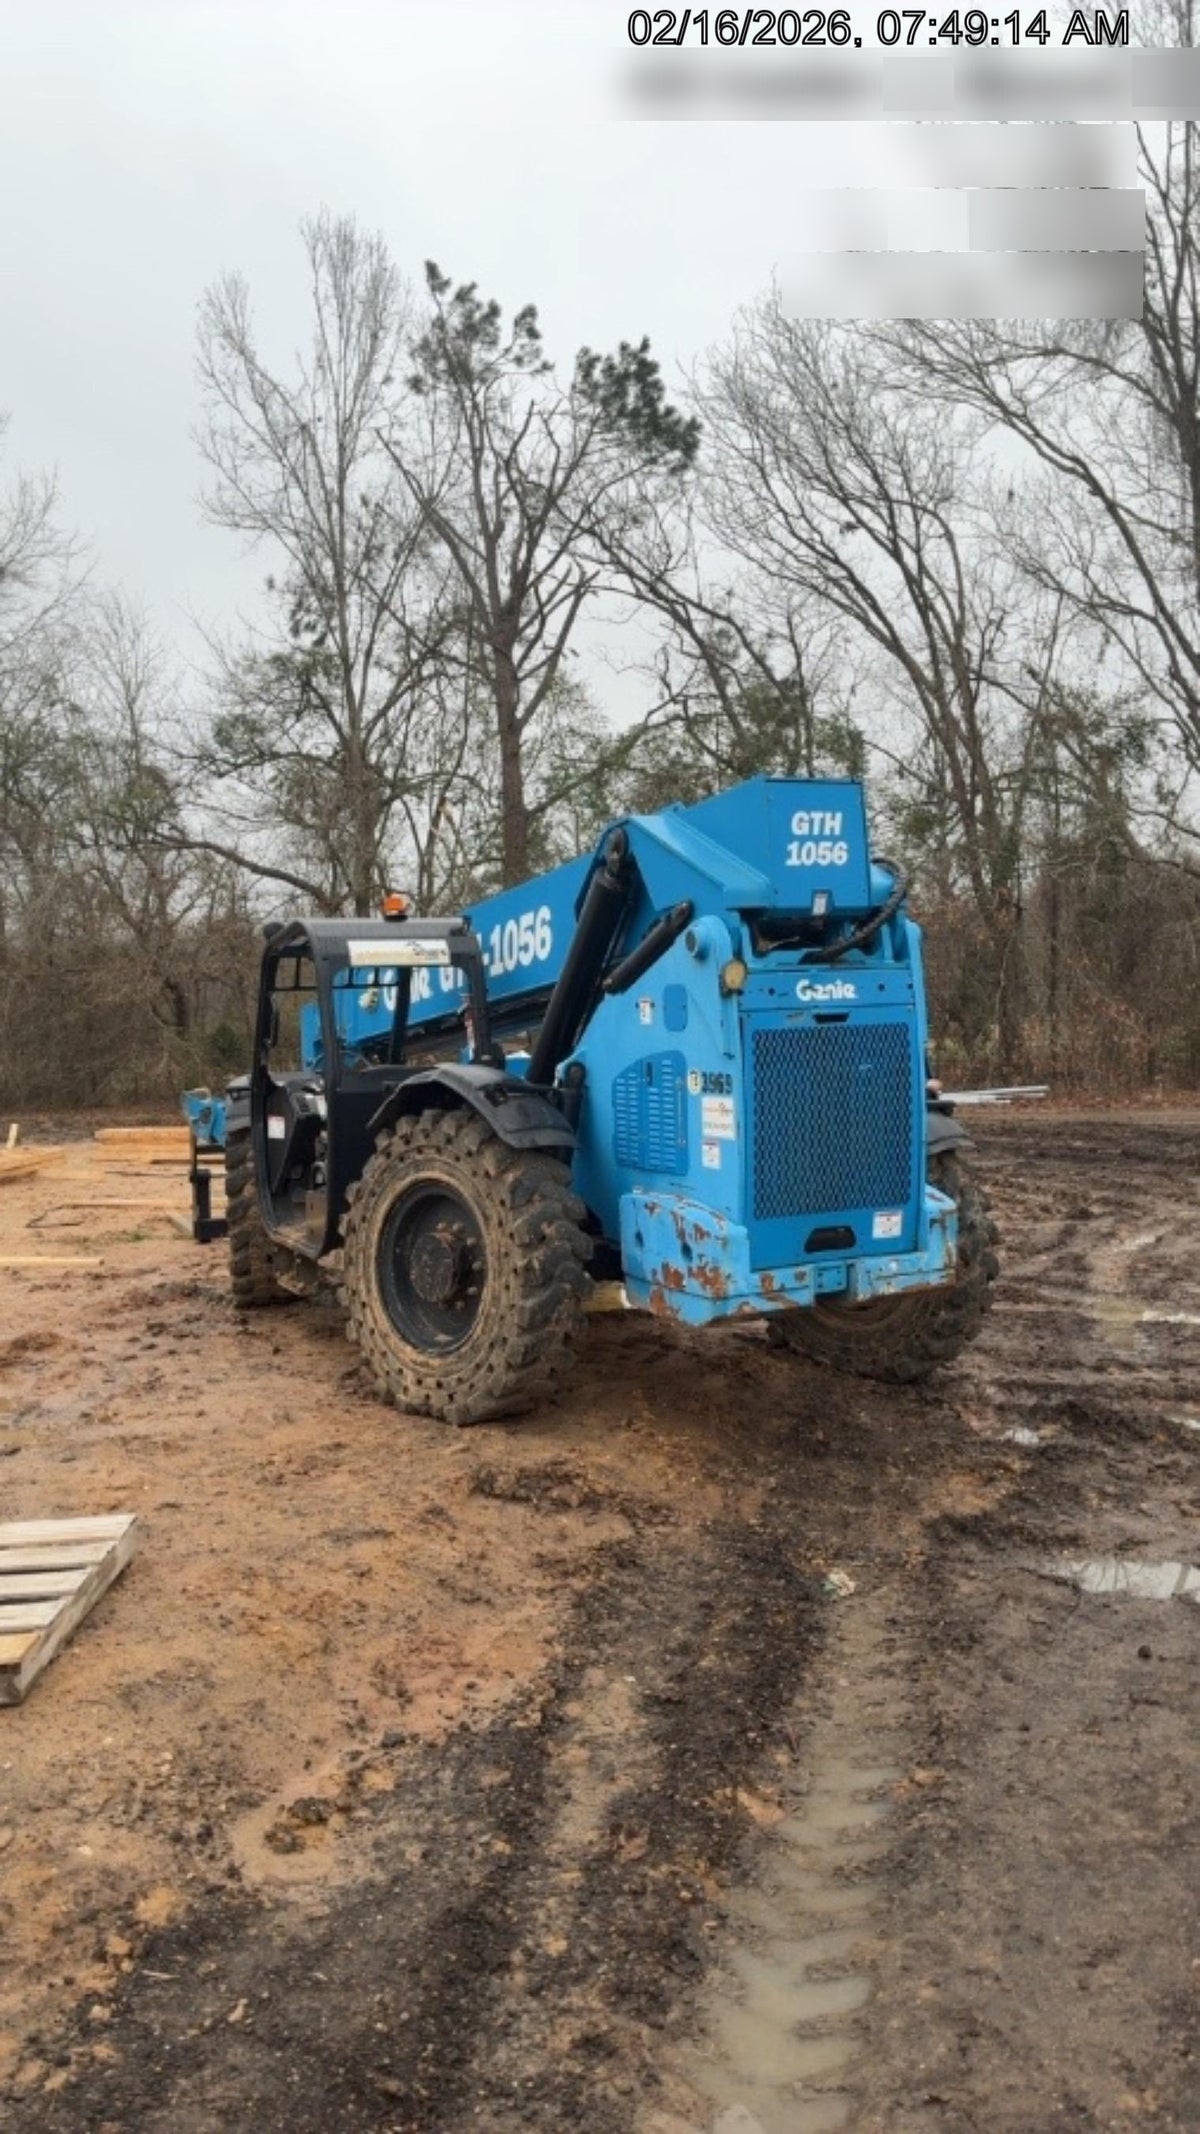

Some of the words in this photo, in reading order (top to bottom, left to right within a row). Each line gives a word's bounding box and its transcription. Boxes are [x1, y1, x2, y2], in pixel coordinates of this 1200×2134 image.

[790, 811, 842, 836] GTH
[785, 841, 848, 866] 1056
[796, 979, 858, 1001] Genie
